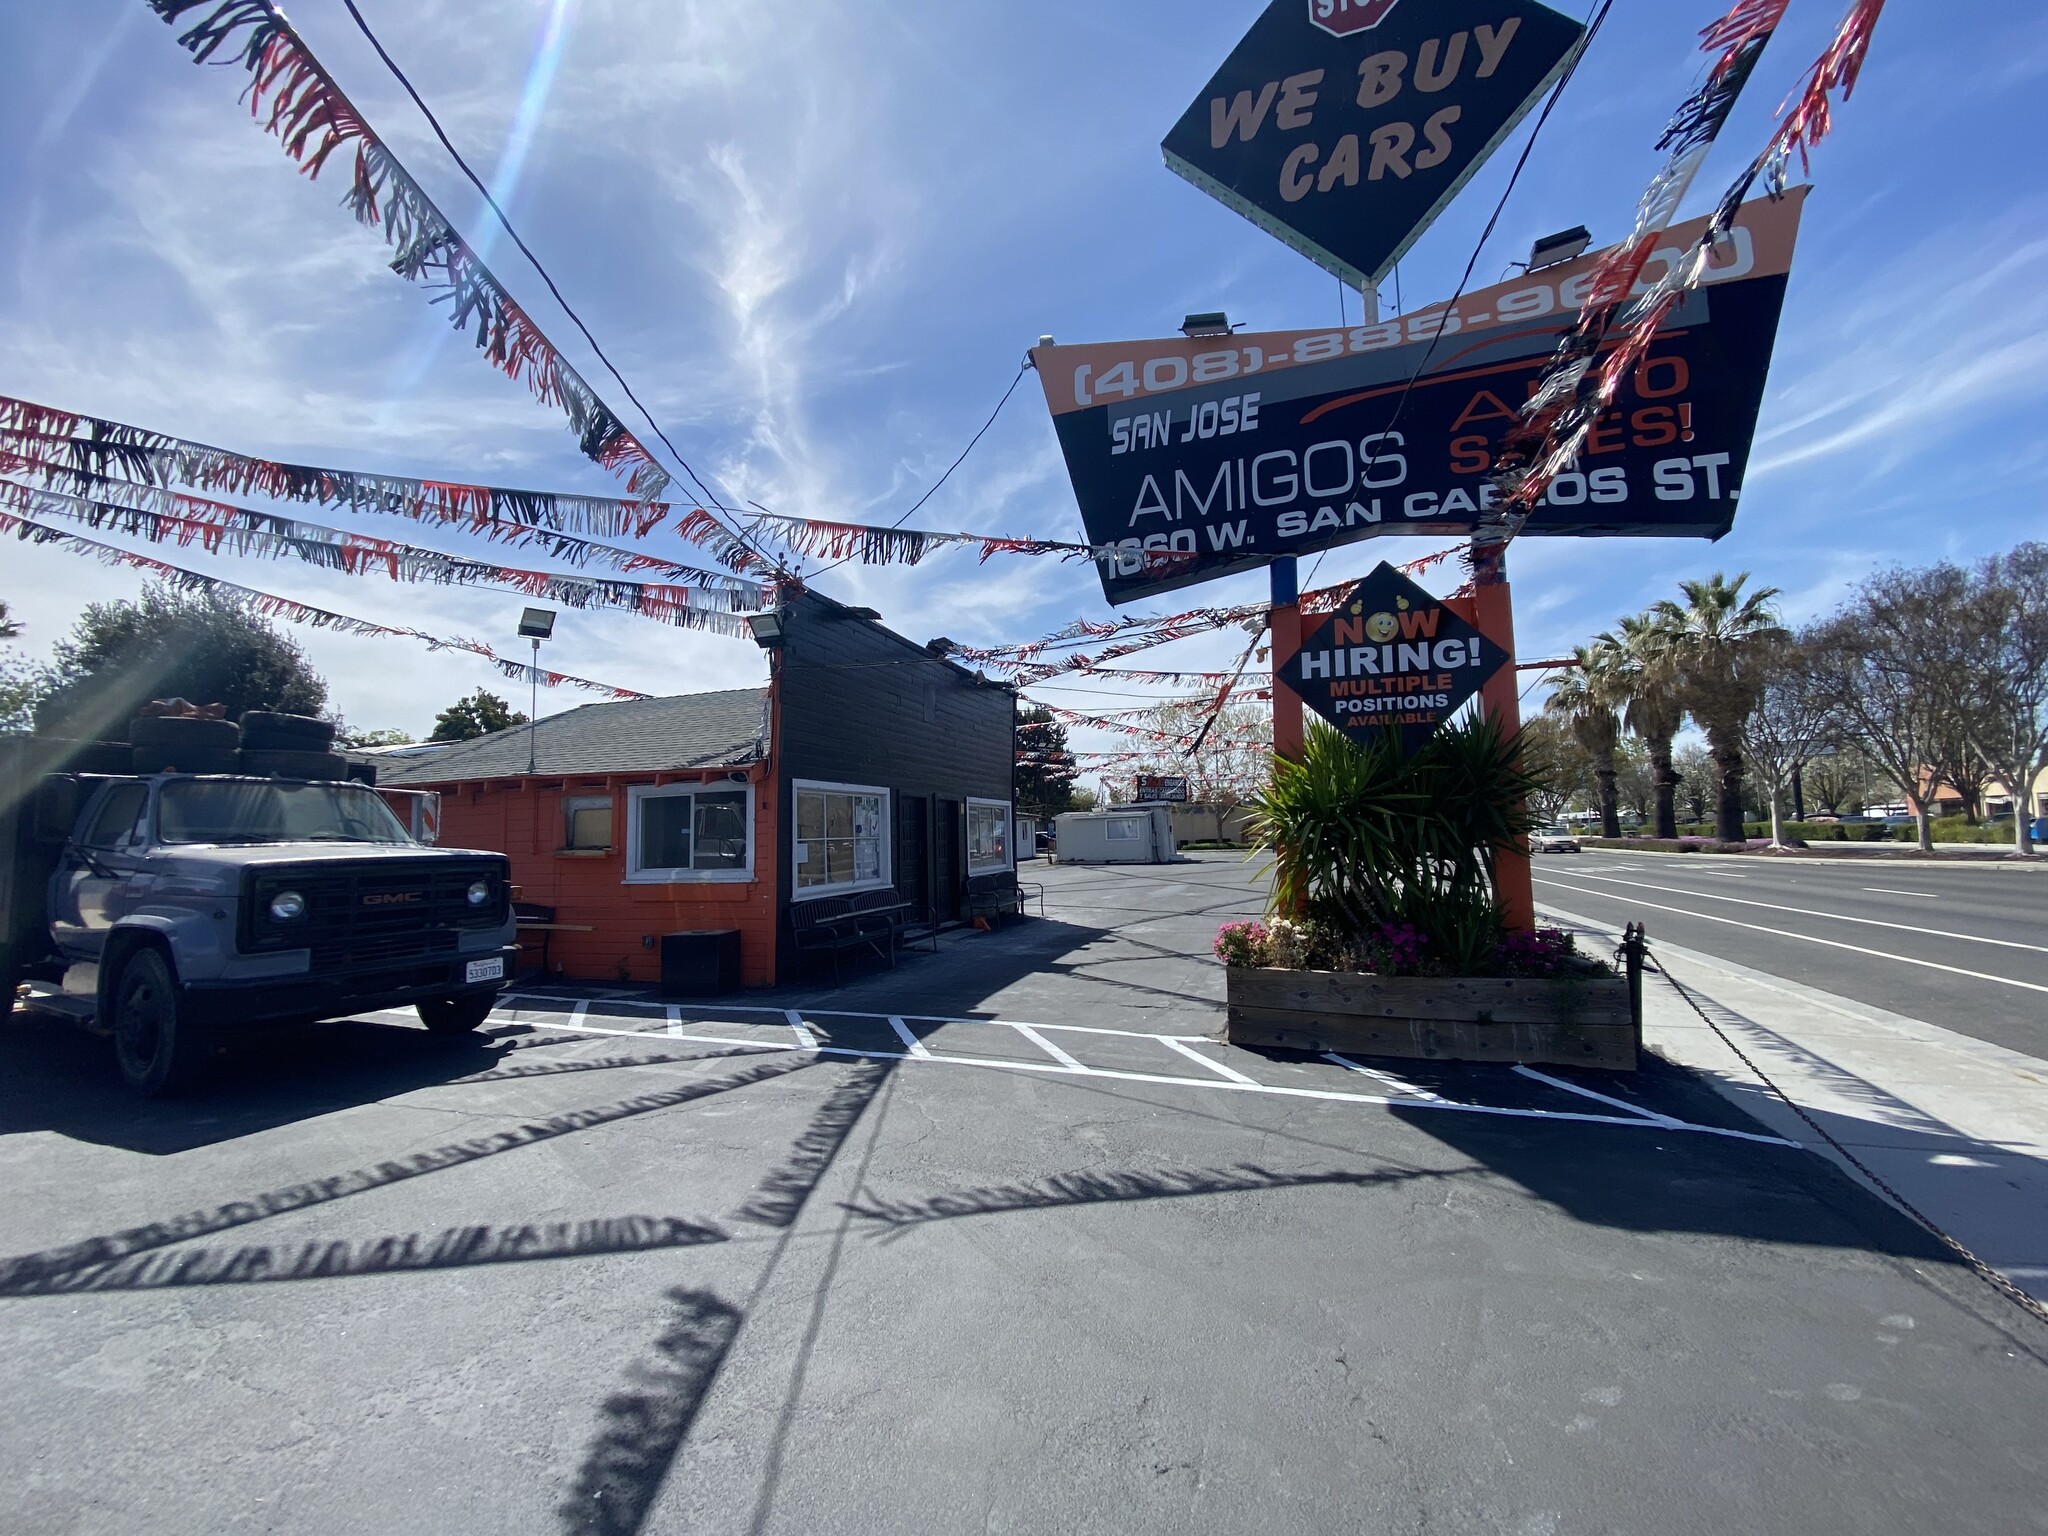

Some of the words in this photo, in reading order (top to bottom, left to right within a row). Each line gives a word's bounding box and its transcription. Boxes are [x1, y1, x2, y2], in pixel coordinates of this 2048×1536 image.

[1210, 68, 1325, 149] WE
[1356, 17, 1522, 109] BUY
[1278, 105, 1462, 202] CARS
[1111, 409, 1172, 455] SAN
[1181, 391, 1261, 443] JOSE
[1449, 356, 1690, 432] AO
[1450, 402, 1695, 474] SES!
[1128, 431, 1408, 527] AMIGOS
[1206, 519, 1255, 552] W.
[1277, 498, 1382, 538] SAN
[1403, 466, 1629, 518] CAOS
[1653, 452, 1740, 501] ST.
[1301, 637, 1481, 680] HIRING!
[1334, 608, 1440, 646] NOW
[1329, 673, 1453, 698] MULTIPLE
[1335, 693, 1449, 714] POSITIONS
[1347, 712, 1437, 728] AVAILABLE
[363, 892, 422, 905] GMC
